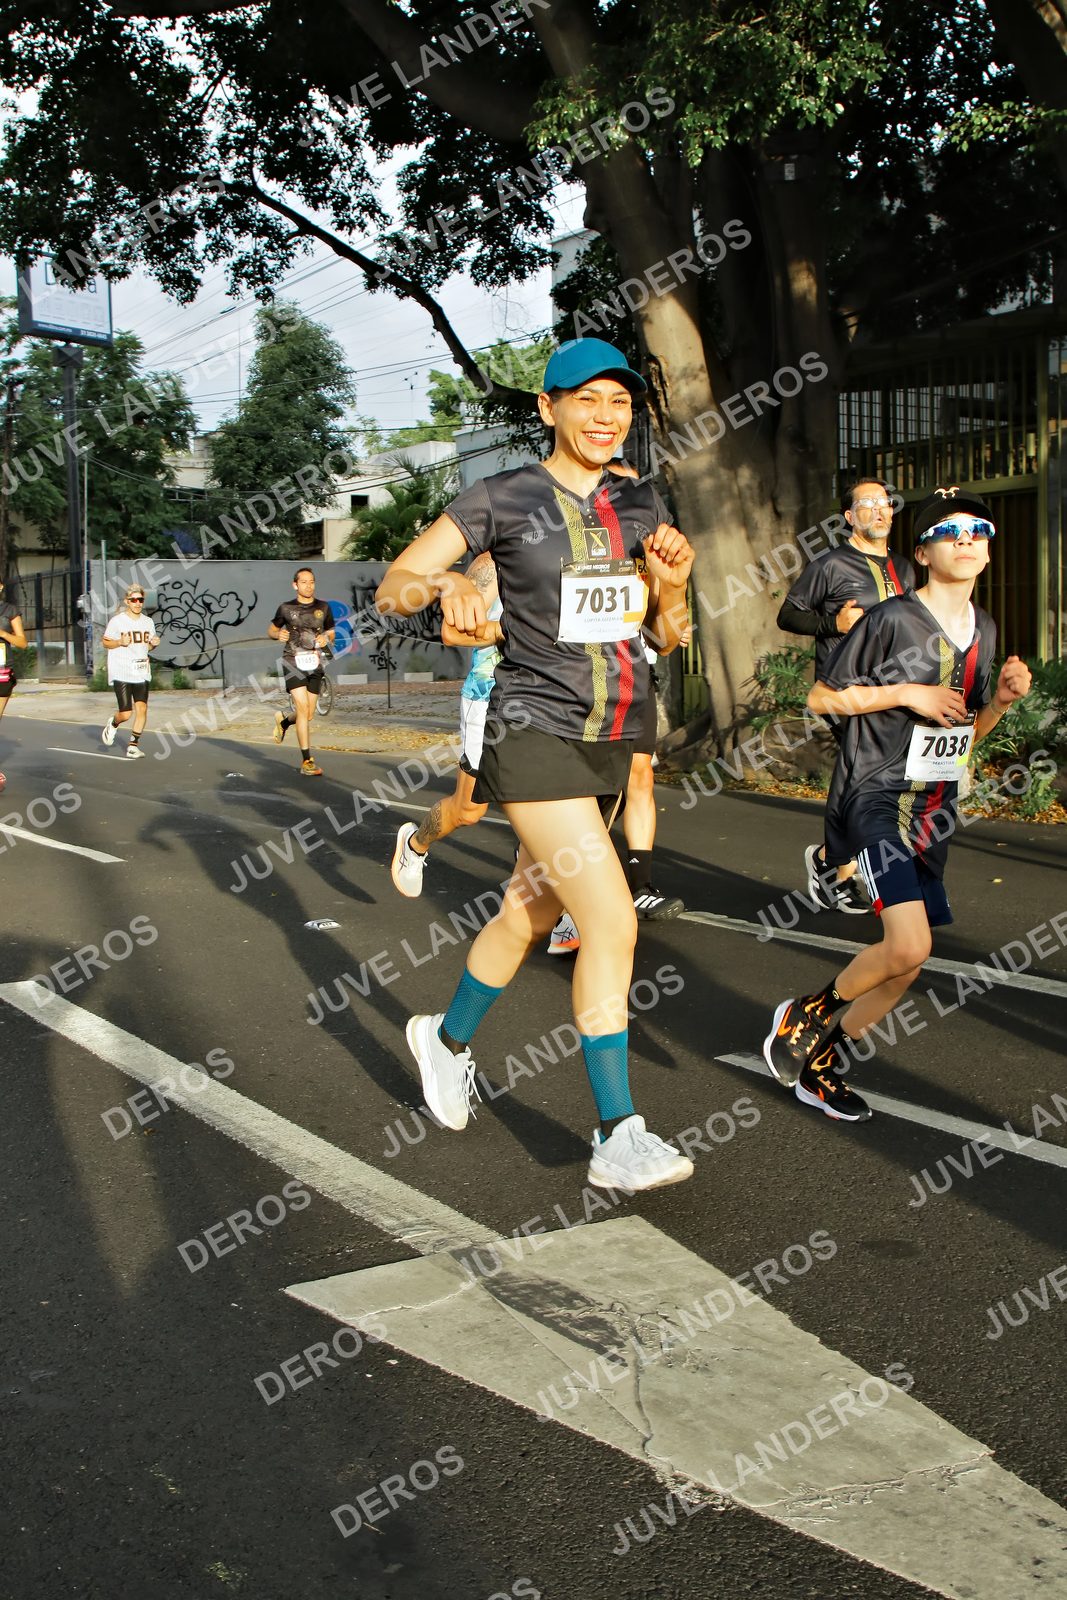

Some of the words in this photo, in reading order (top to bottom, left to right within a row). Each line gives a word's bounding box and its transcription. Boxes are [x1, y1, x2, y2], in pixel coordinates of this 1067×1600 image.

[159, 578, 199, 595] TOY
[575, 586, 630, 614] 7031
[921, 735, 969, 758] 7038
